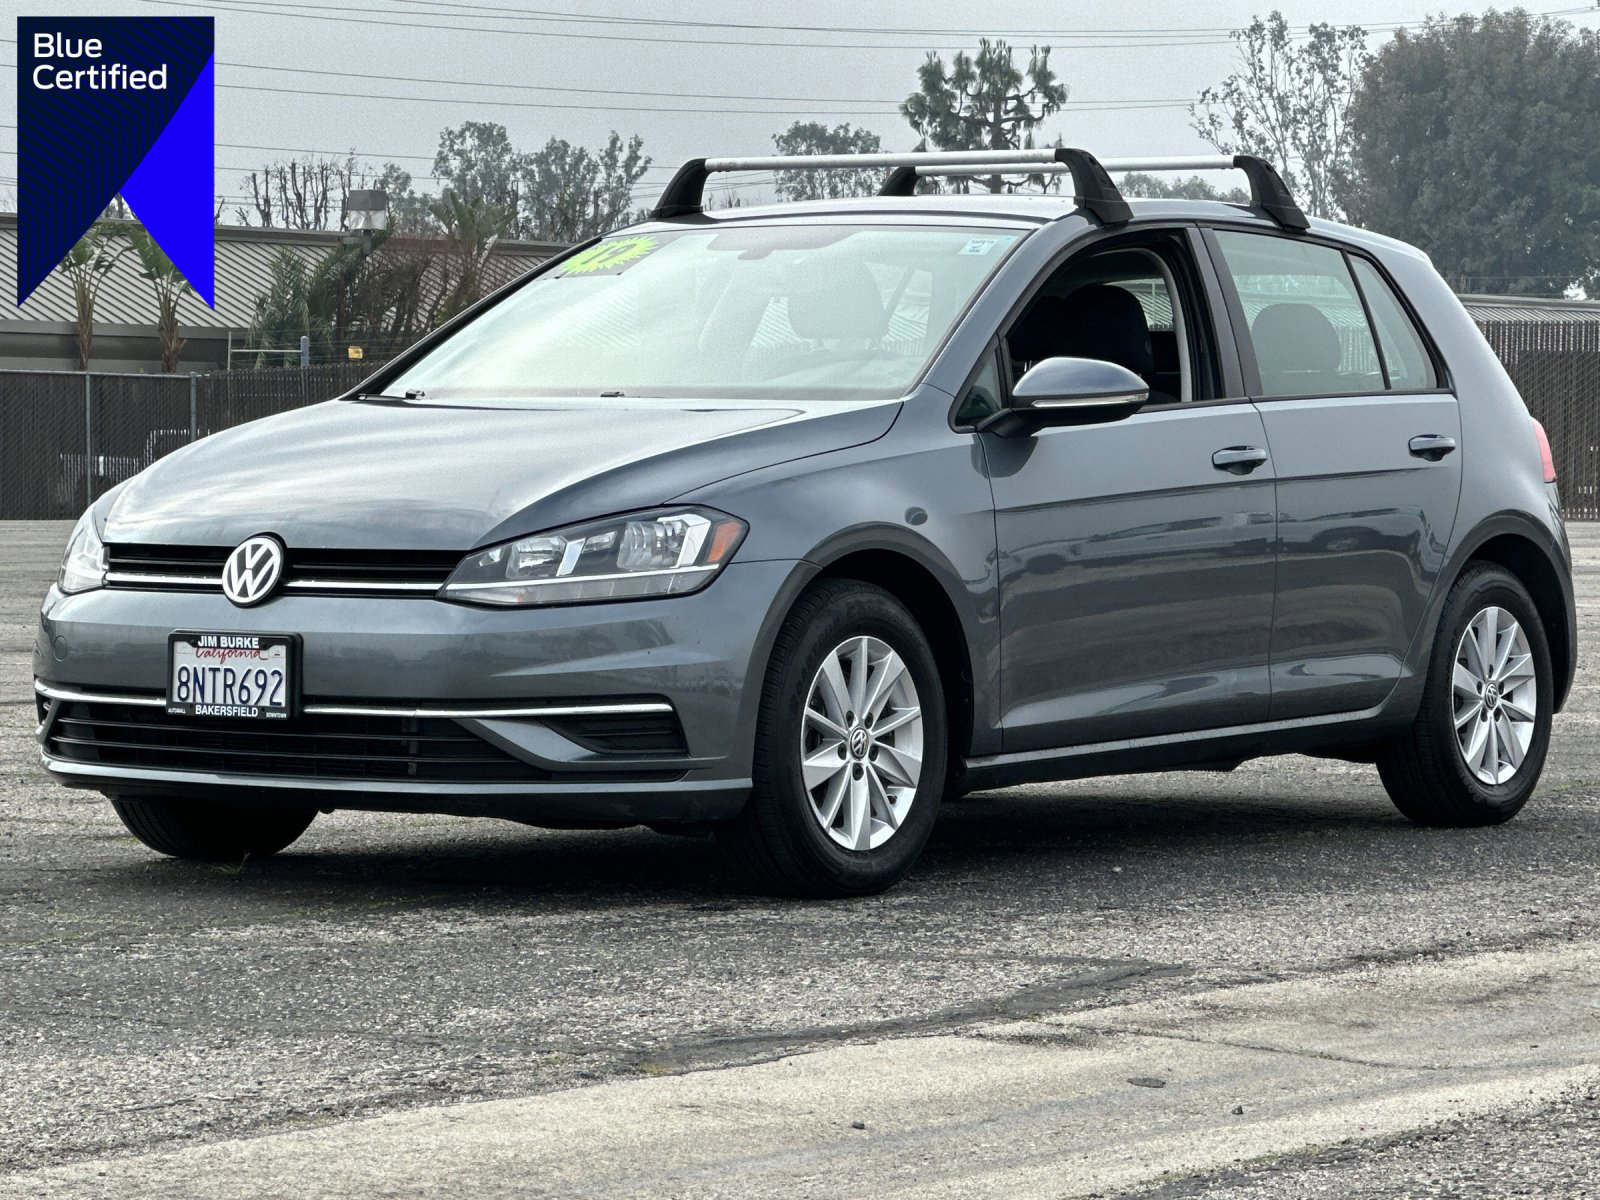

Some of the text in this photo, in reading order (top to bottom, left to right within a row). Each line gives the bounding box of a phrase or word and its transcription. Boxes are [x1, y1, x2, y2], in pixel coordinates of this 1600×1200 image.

[197, 635, 260, 649] JIM BURKE
[195, 648, 269, 665] California
[177, 665, 284, 707] 8NTR692
[195, 704, 259, 717] BAKERSFIELD
